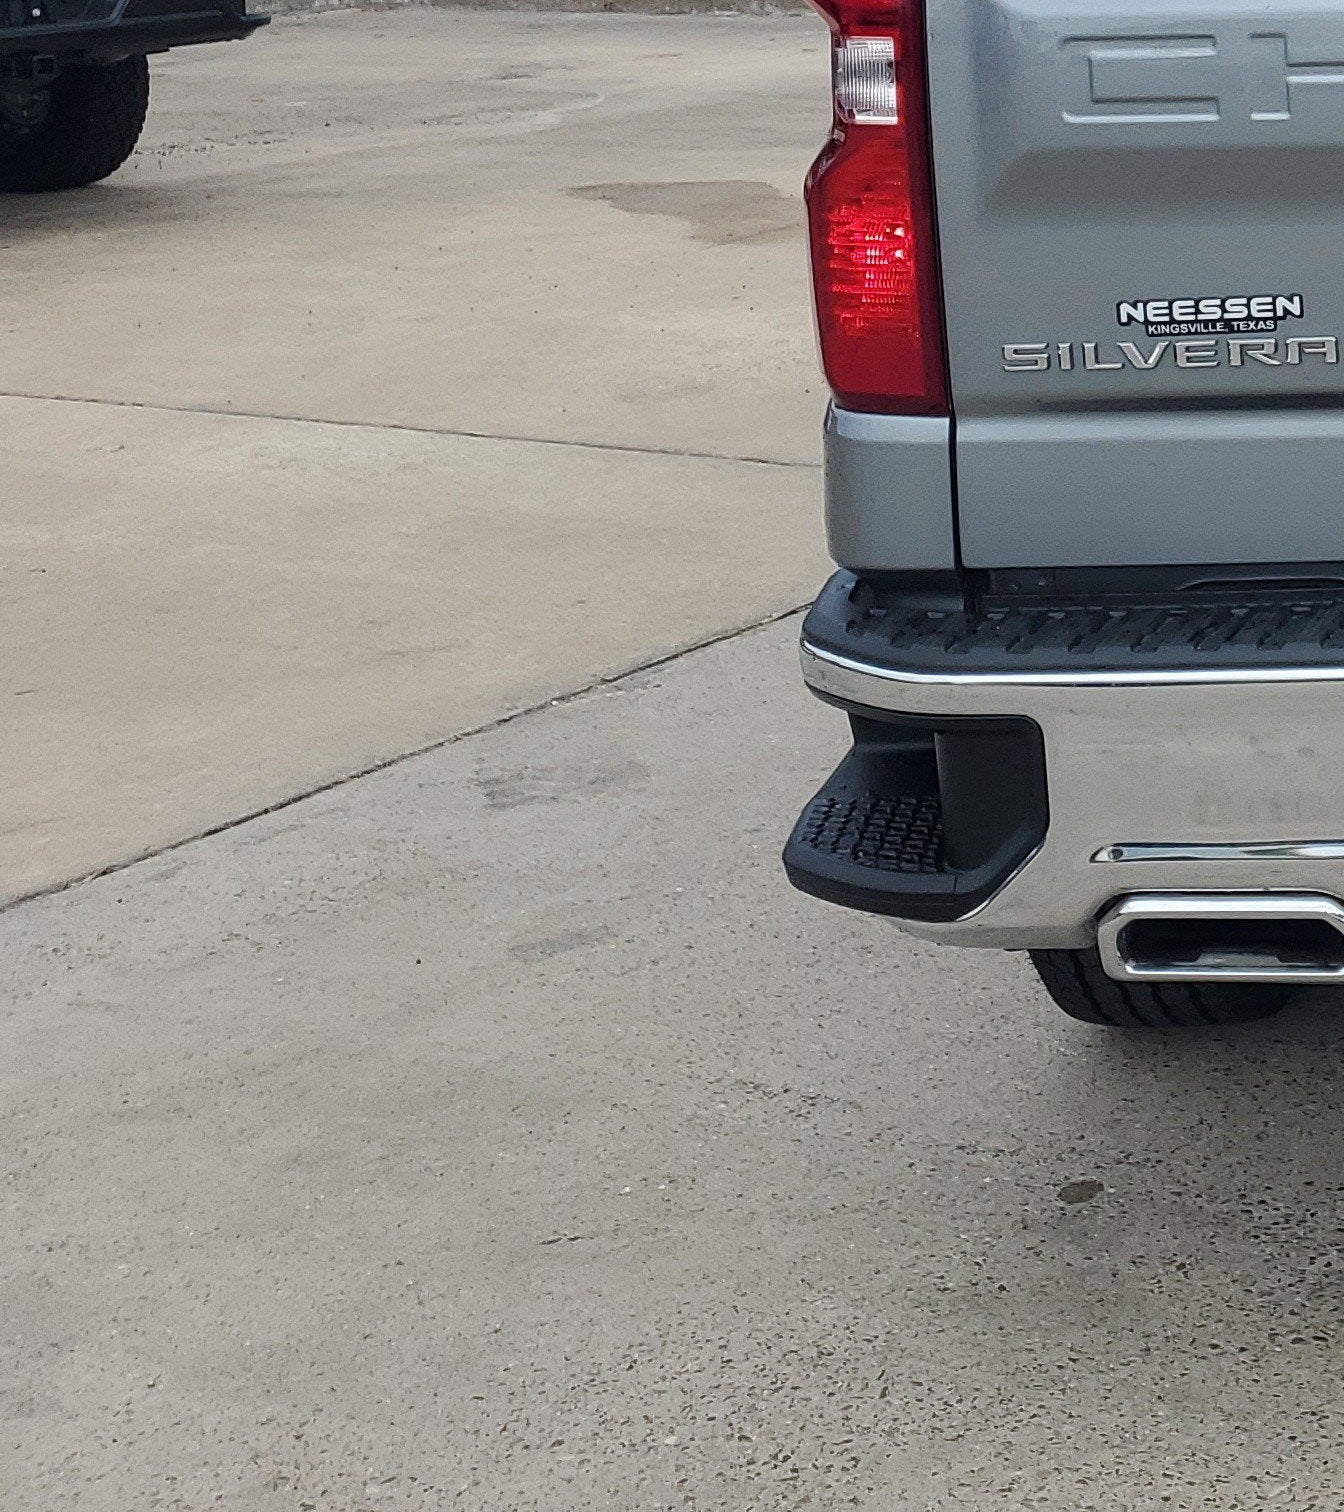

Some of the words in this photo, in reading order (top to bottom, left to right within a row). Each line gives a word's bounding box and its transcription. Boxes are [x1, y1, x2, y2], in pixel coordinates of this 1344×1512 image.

[1119, 296, 1302, 324] NEESSEN
[1147, 321, 1229, 335] KINGSVILLE,
[1231, 319, 1275, 331] TEXAS
